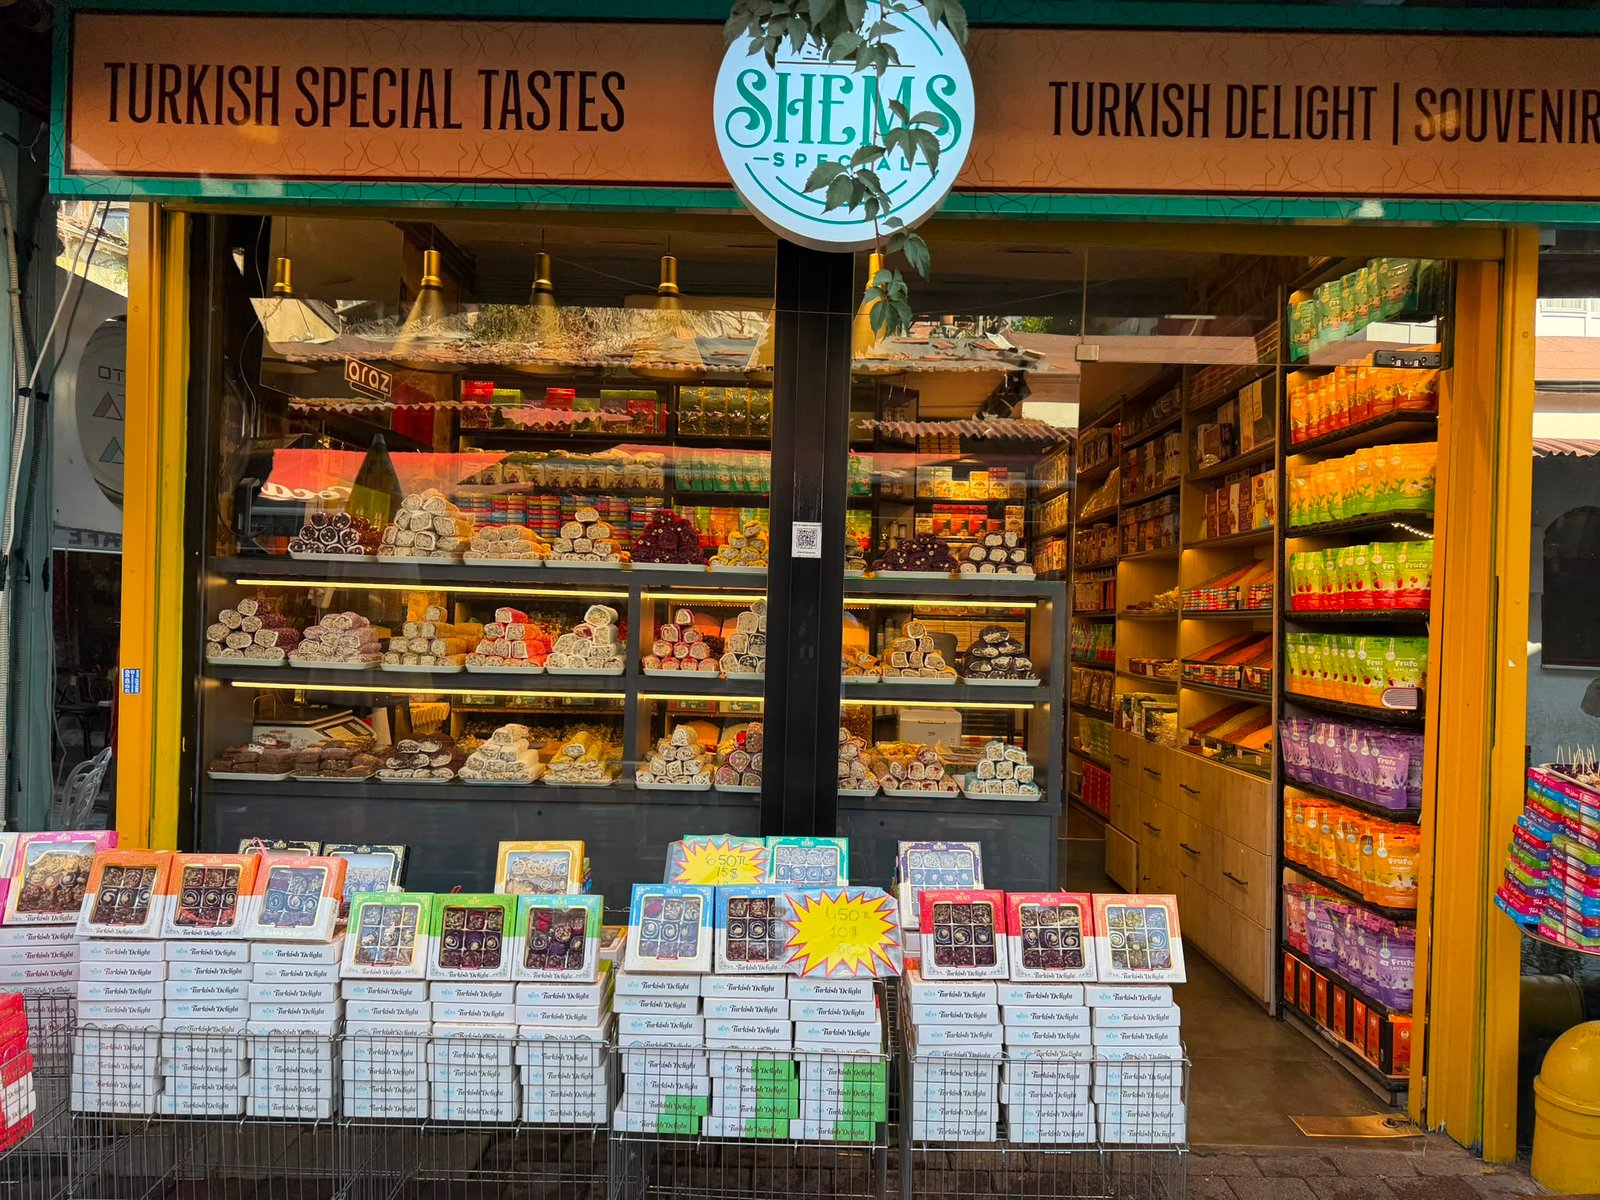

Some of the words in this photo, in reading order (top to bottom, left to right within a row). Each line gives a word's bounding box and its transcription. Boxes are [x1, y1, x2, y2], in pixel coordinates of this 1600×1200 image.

[104, 61, 280, 127] TURKISH
[295, 65, 463, 130] SPECIAL
[478, 69, 626, 132] TASTES
[725, 68, 962, 154] SHEMS
[1049, 81, 1210, 139] TURKISH
[1225, 83, 1378, 142] DELIGHT
[1414, 86, 1600, 144] SOUVENIR
[348, 361, 390, 393] araz
[51, 932, 74, 940] Delight
[50, 951, 73, 959] Delight
[103, 947, 128, 955] Turkish
[128, 949, 150, 957] Delight
[214, 949, 236, 957] Delight
[275, 949, 300, 957] Turkish
[300, 950, 322, 958] Delight
[50, 969, 73, 977] Delight
[103, 967, 128, 975] Turkish
[129, 968, 152, 976] Delight
[193, 967, 218, 975] Turkish
[219, 968, 242, 976] Delight
[304, 970, 327, 978] Delight
[129, 987, 152, 995] Delight
[216, 986, 239, 994] Delight
[366, 986, 390, 994] Turkish
[390, 988, 413, 996] Delight
[640, 982, 666, 990] Turkish
[666, 983, 689, 991] Delight
[726, 983, 751, 991] Turkish
[752, 984, 775, 992] Delight
[813, 986, 838, 994] Turkish
[839, 987, 862, 995] Delight
[299, 989, 322, 997] Delight
[455, 989, 479, 997] Turkish
[480, 990, 502, 998] Delight
[541, 991, 566, 999] Turkish
[567, 992, 590, 1000] Delight
[937, 990, 962, 998] Turkish
[963, 991, 986, 999] Delight
[1024, 991, 1049, 999] Turkish
[1050, 992, 1073, 1000] Delight
[1112, 993, 1138, 1001] Turkish
[1138, 994, 1161, 1003] Delight
[638, 1000, 663, 1008] Turkish
[664, 1001, 687, 1009] Delight
[729, 1004, 754, 1012] Turkish
[755, 1005, 778, 1014] Delight
[102, 1006, 127, 1014] Turkish
[128, 1006, 151, 1015] Delight
[216, 1006, 239, 1014] Delight
[302, 1007, 325, 1015] Delight
[370, 1007, 396, 1015] Turkish
[396, 1008, 419, 1017] Delight
[456, 1009, 482, 1017] Turkish
[482, 1010, 505, 1018] Delight
[816, 1007, 841, 1015] Turkish
[842, 1008, 865, 1017] Delight
[539, 1012, 564, 1020] Turkish
[565, 1013, 588, 1022] Delight
[938, 1011, 963, 1019] Turkish
[964, 1012, 987, 1020] Delight
[1030, 1012, 1055, 1020] Turkish
[1056, 1012, 1079, 1021] Delight
[1147, 1013, 1170, 1021] Delight
[644, 1021, 669, 1029] Turkish
[670, 1022, 693, 1030] Delight
[731, 1025, 756, 1033] Turkish
[757, 1026, 780, 1034] Delight
[821, 1028, 847, 1036] Turkish
[847, 1029, 870, 1038] Delight
[944, 1031, 969, 1039] Turkish
[970, 1032, 993, 1040] Delight
[1057, 1032, 1080, 1040] Delight
[1119, 1032, 1144, 1040] Turkish
[1145, 1033, 1168, 1041] Delight
